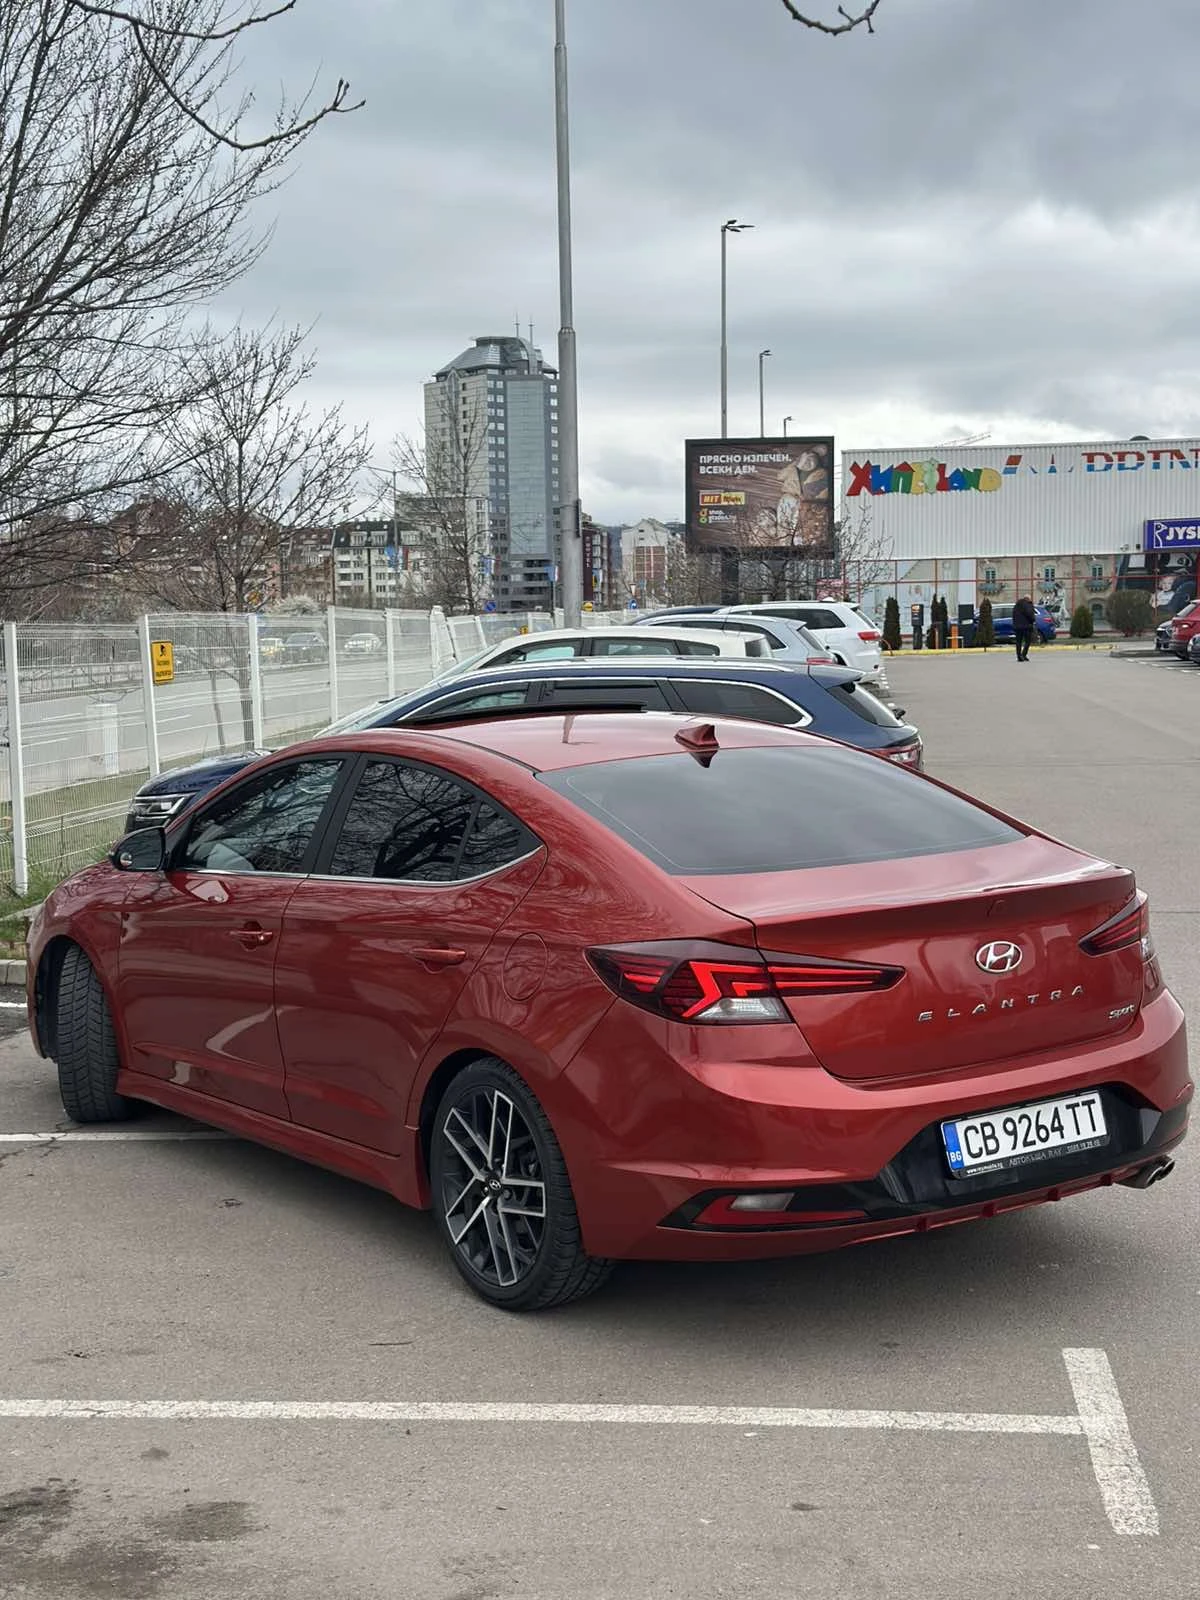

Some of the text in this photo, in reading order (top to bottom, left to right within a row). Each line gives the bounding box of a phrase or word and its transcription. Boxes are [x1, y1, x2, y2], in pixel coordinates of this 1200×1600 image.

[699, 453, 792, 464] ПРЯСНО ИЗПЕЧЕН.
[699, 465, 758, 475] ВСЕКИ ДЕН.
[918, 984, 1083, 1022] ELANTRA
[1108, 1004, 1135, 1020] Sport
[950, 1151, 962, 1163] BG
